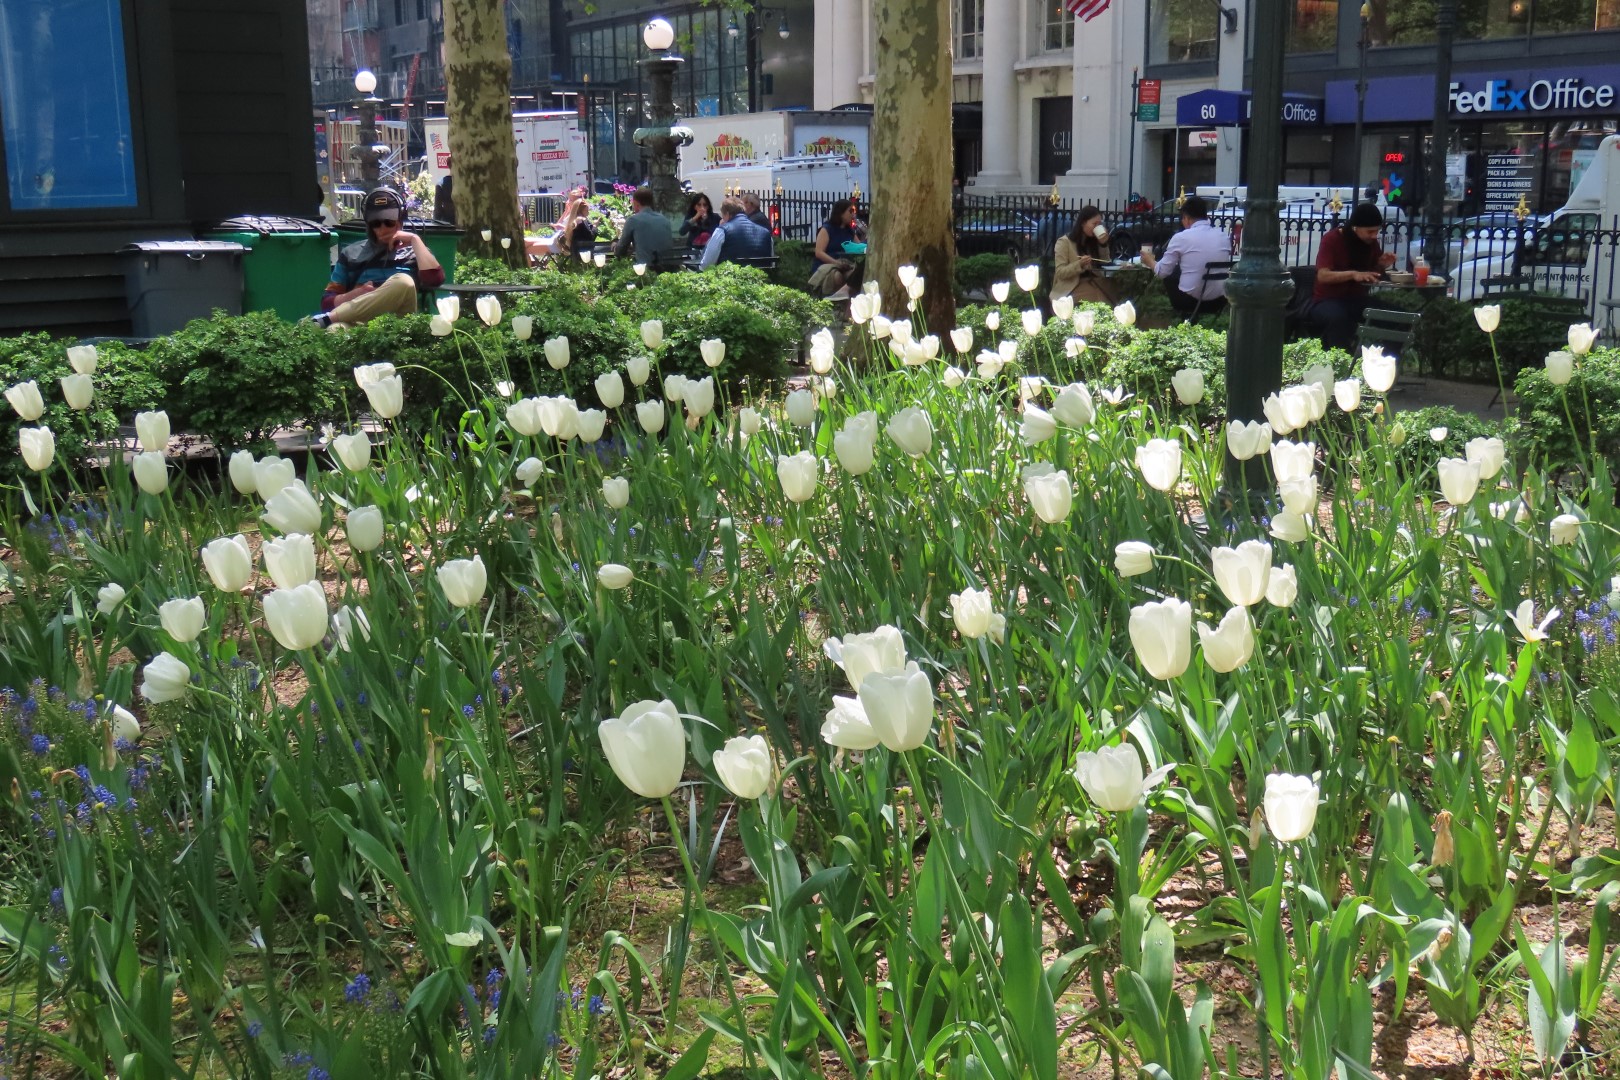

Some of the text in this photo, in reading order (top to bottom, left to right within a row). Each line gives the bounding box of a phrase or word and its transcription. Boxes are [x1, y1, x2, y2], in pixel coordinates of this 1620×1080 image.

[1449, 78, 1614, 113] FedEx Office
[1201, 104, 1216, 119] 60
[1284, 103, 1316, 121] Office
[1385, 153, 1403, 162] OPEN
[1535, 272, 1590, 283] MANTENANCE
